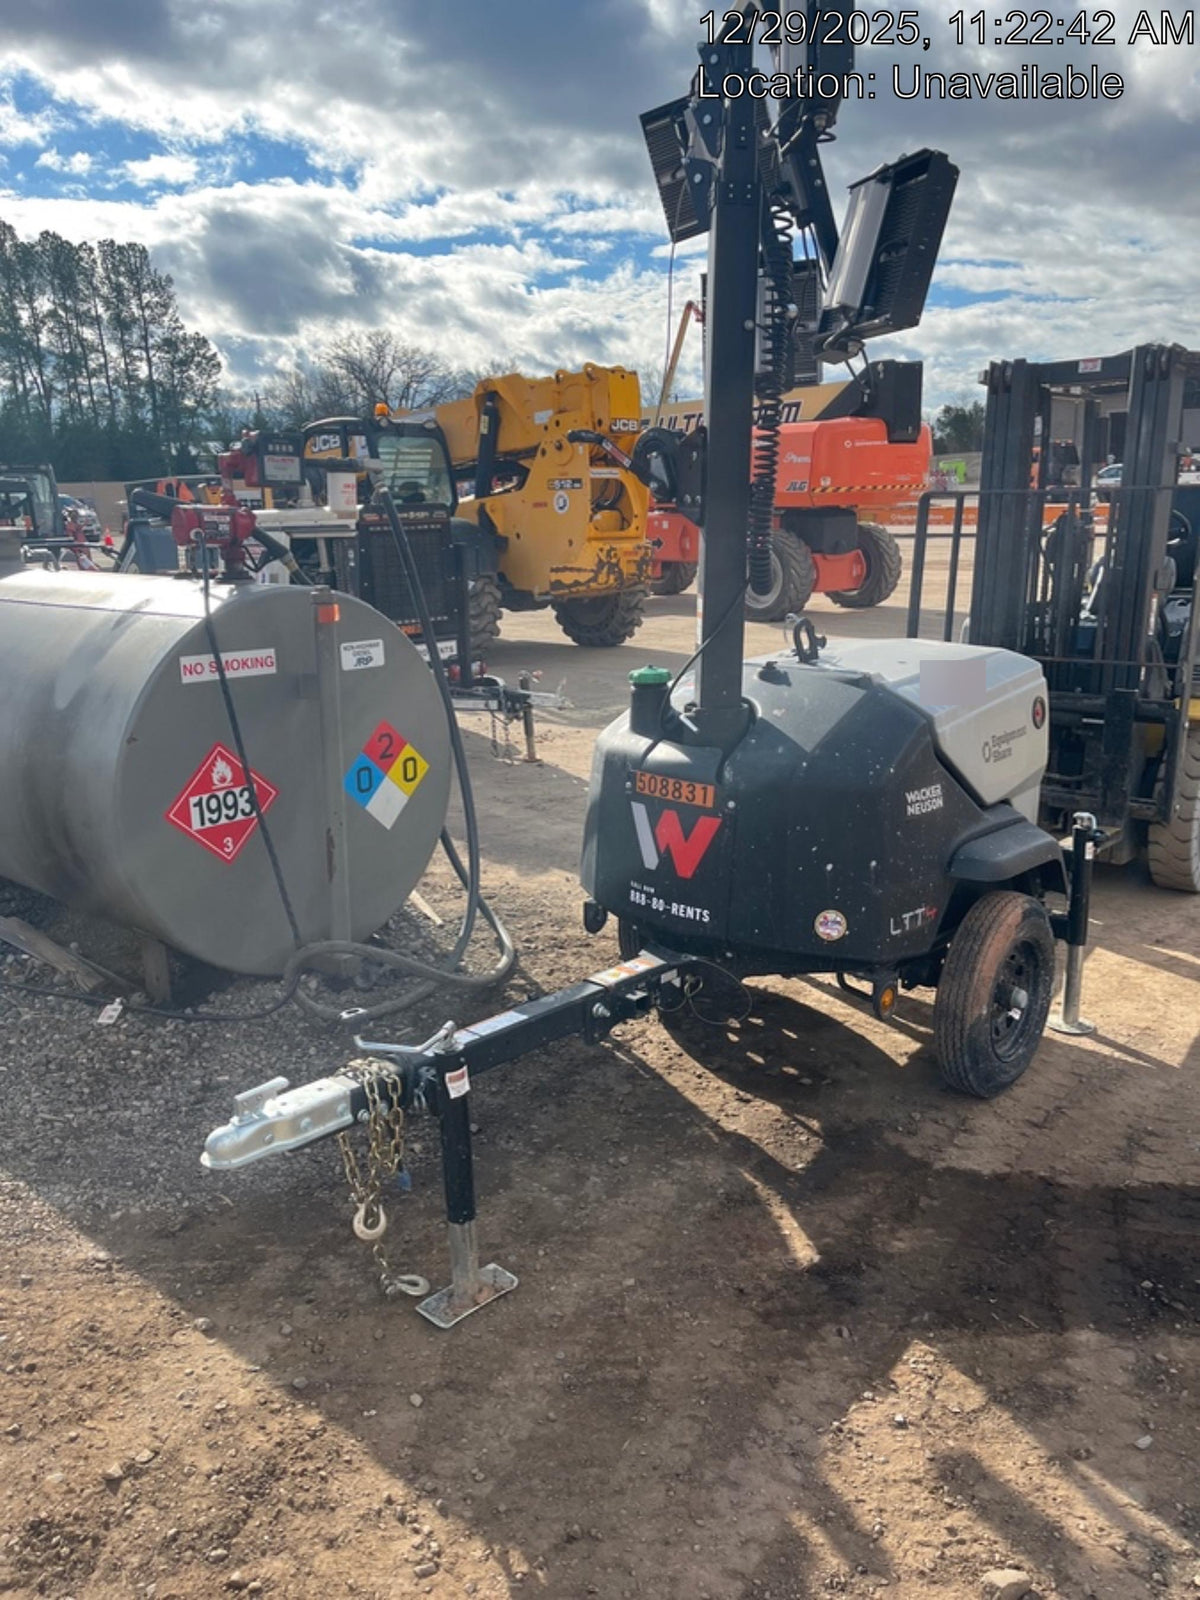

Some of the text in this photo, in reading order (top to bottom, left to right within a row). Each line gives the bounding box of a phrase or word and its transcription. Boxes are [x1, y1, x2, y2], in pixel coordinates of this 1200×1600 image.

[611, 419, 638, 431] JCB
[311, 434, 340, 452] JCB
[183, 655, 274, 676] NO SMOKING
[377, 733, 394, 760] 2
[356, 757, 417, 794] 0 0
[637, 772, 709, 805] 508831
[905, 784, 942, 803] WACKER
[192, 788, 256, 826] 1993
[906, 797, 943, 816] NEUSON
[223, 837, 234, 852] 3
